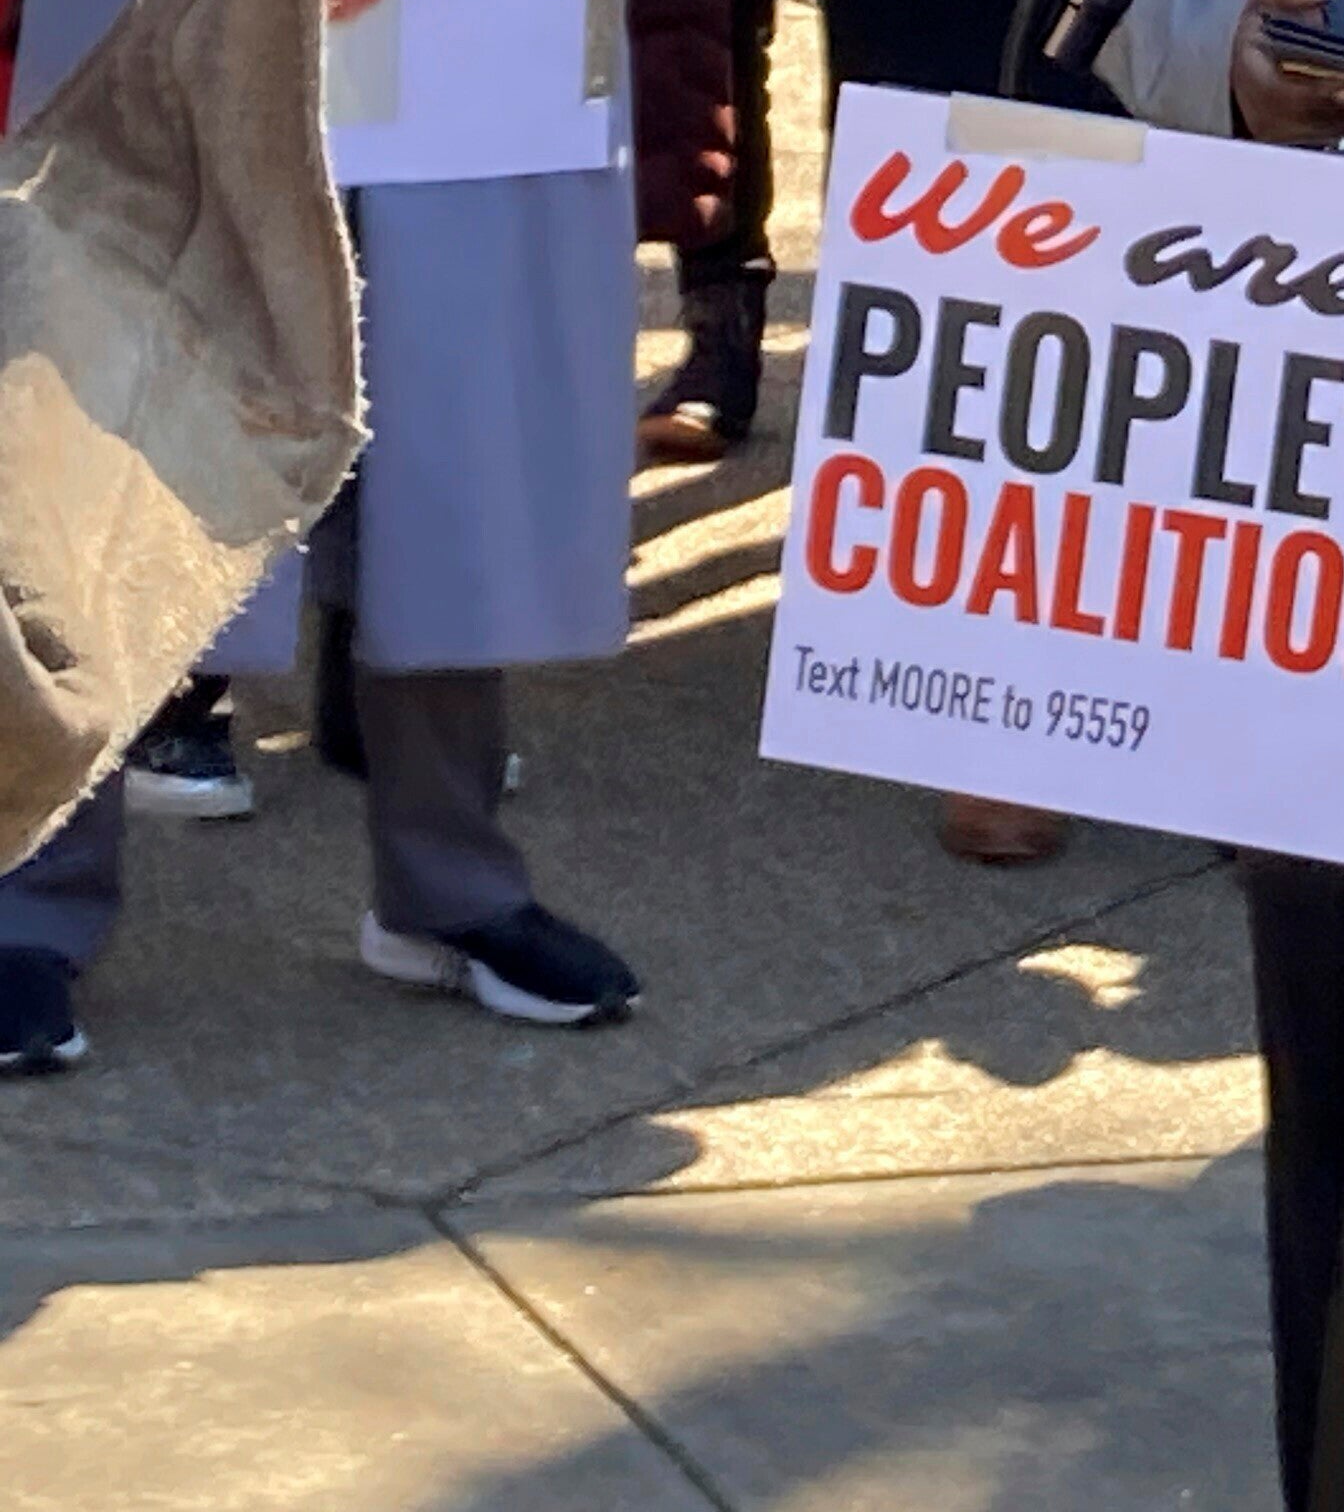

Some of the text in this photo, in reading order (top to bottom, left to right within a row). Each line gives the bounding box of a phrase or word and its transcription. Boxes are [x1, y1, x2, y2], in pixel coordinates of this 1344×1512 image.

[849, 150, 1102, 269] We
[793, 645, 1151, 752] Text MOORE to 95559
